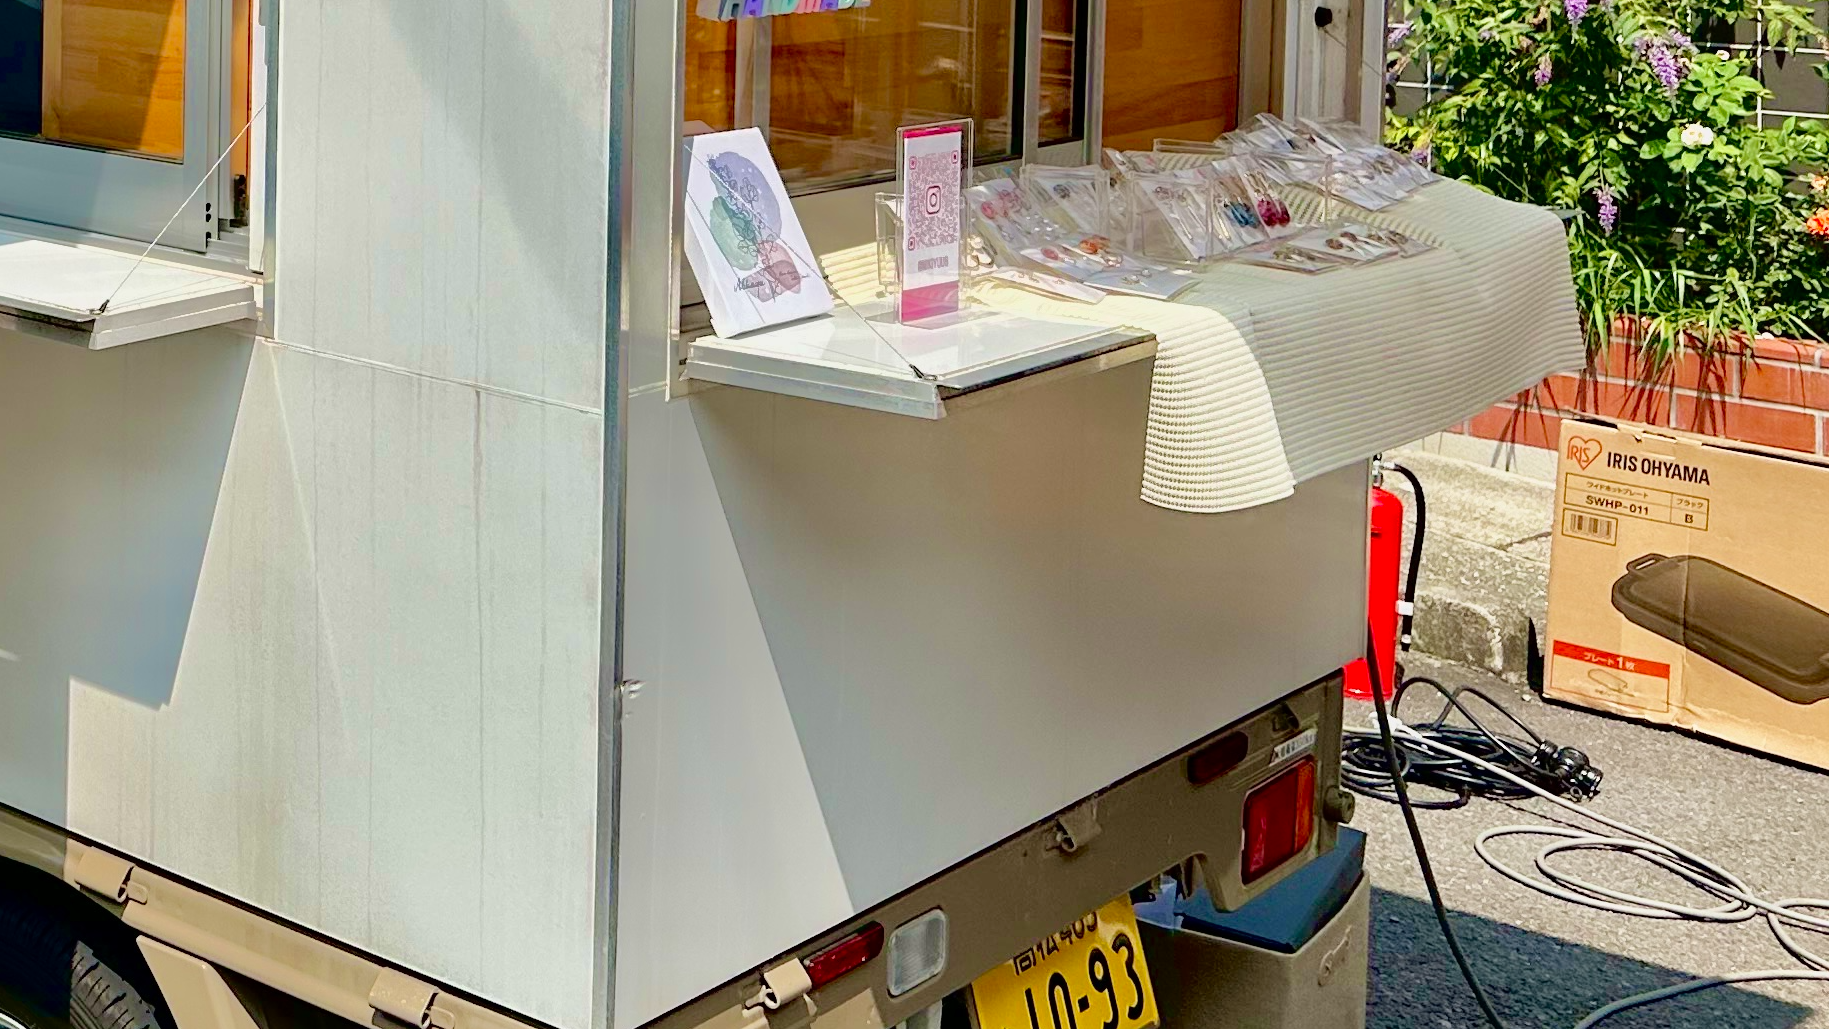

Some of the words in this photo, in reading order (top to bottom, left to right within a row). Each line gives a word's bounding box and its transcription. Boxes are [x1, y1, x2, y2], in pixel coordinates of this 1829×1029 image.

[1607, 451, 1638, 472] IRIS
[1641, 458, 1711, 486] OHYAMA
[1585, 494, 1649, 516] SWHP-011
